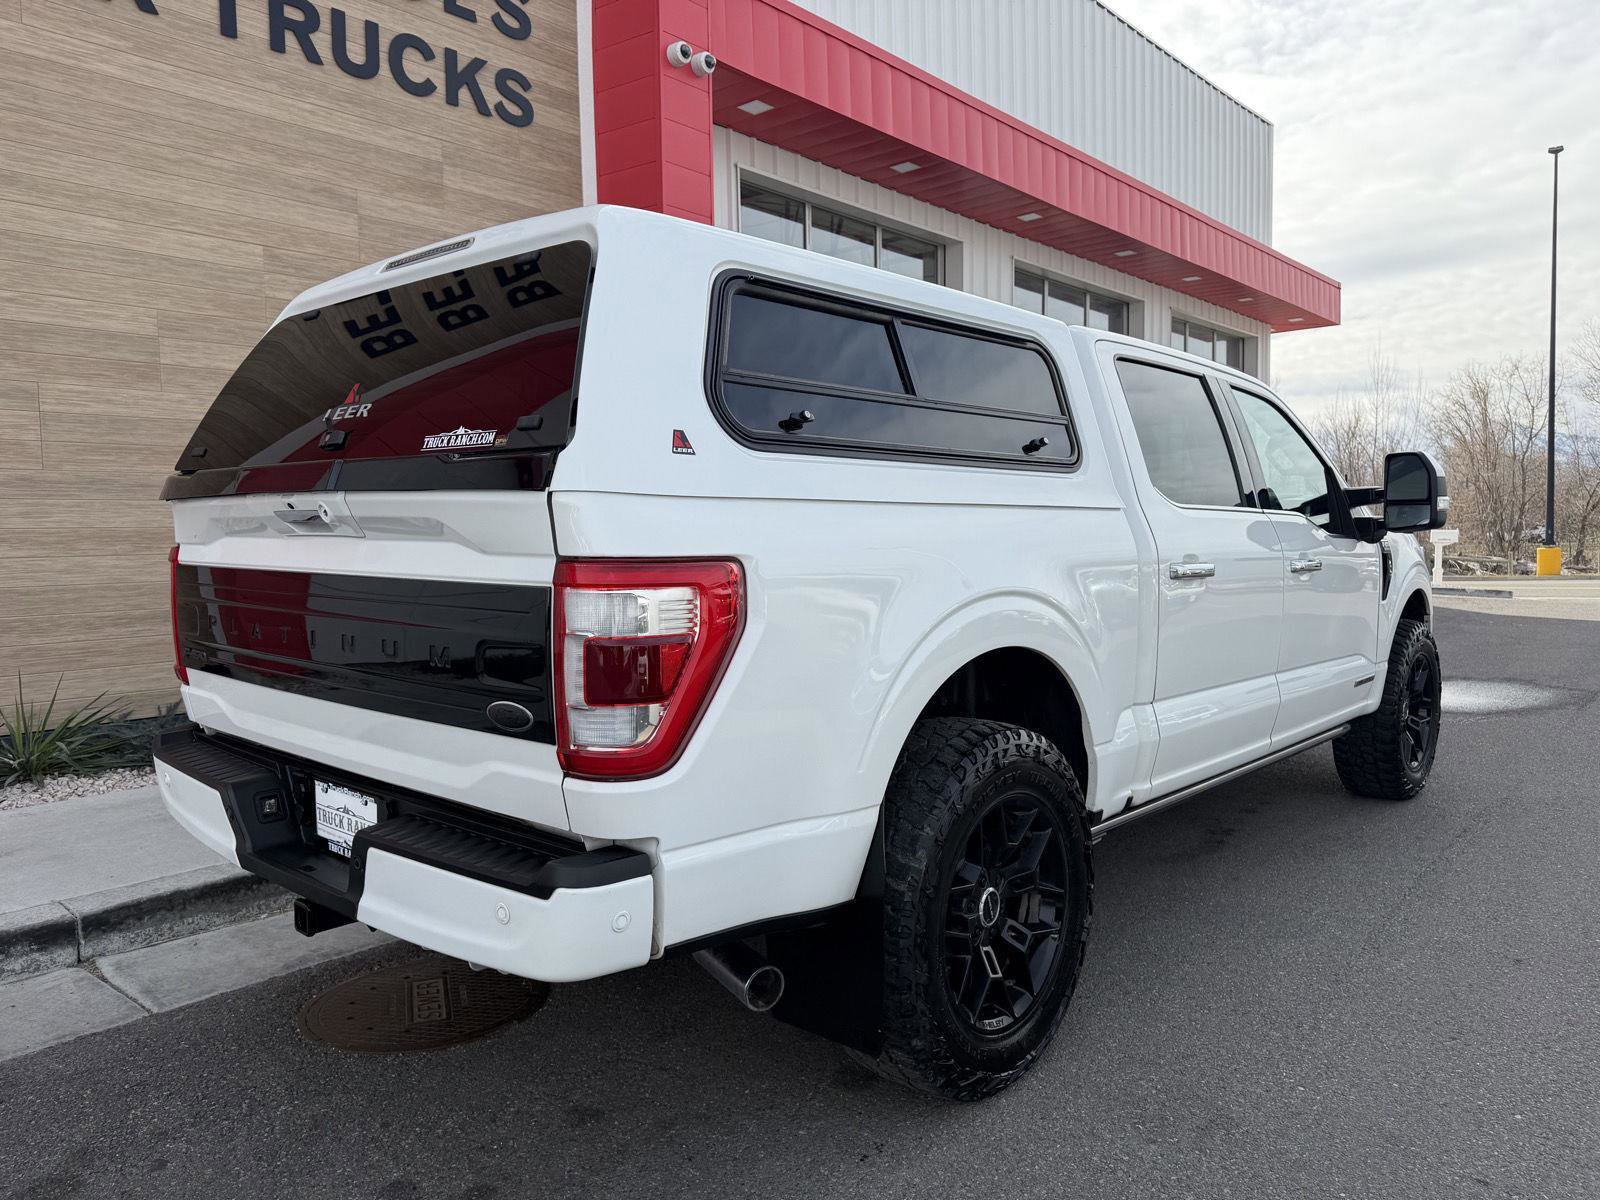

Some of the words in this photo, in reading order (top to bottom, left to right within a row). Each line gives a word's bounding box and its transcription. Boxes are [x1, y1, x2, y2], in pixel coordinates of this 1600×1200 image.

[422, 435, 450, 449] TRUCK
[208, 614, 451, 668] PLATINUM
[316, 807, 345, 830] TRUCK
[416, 981, 441, 1019] SEWER
